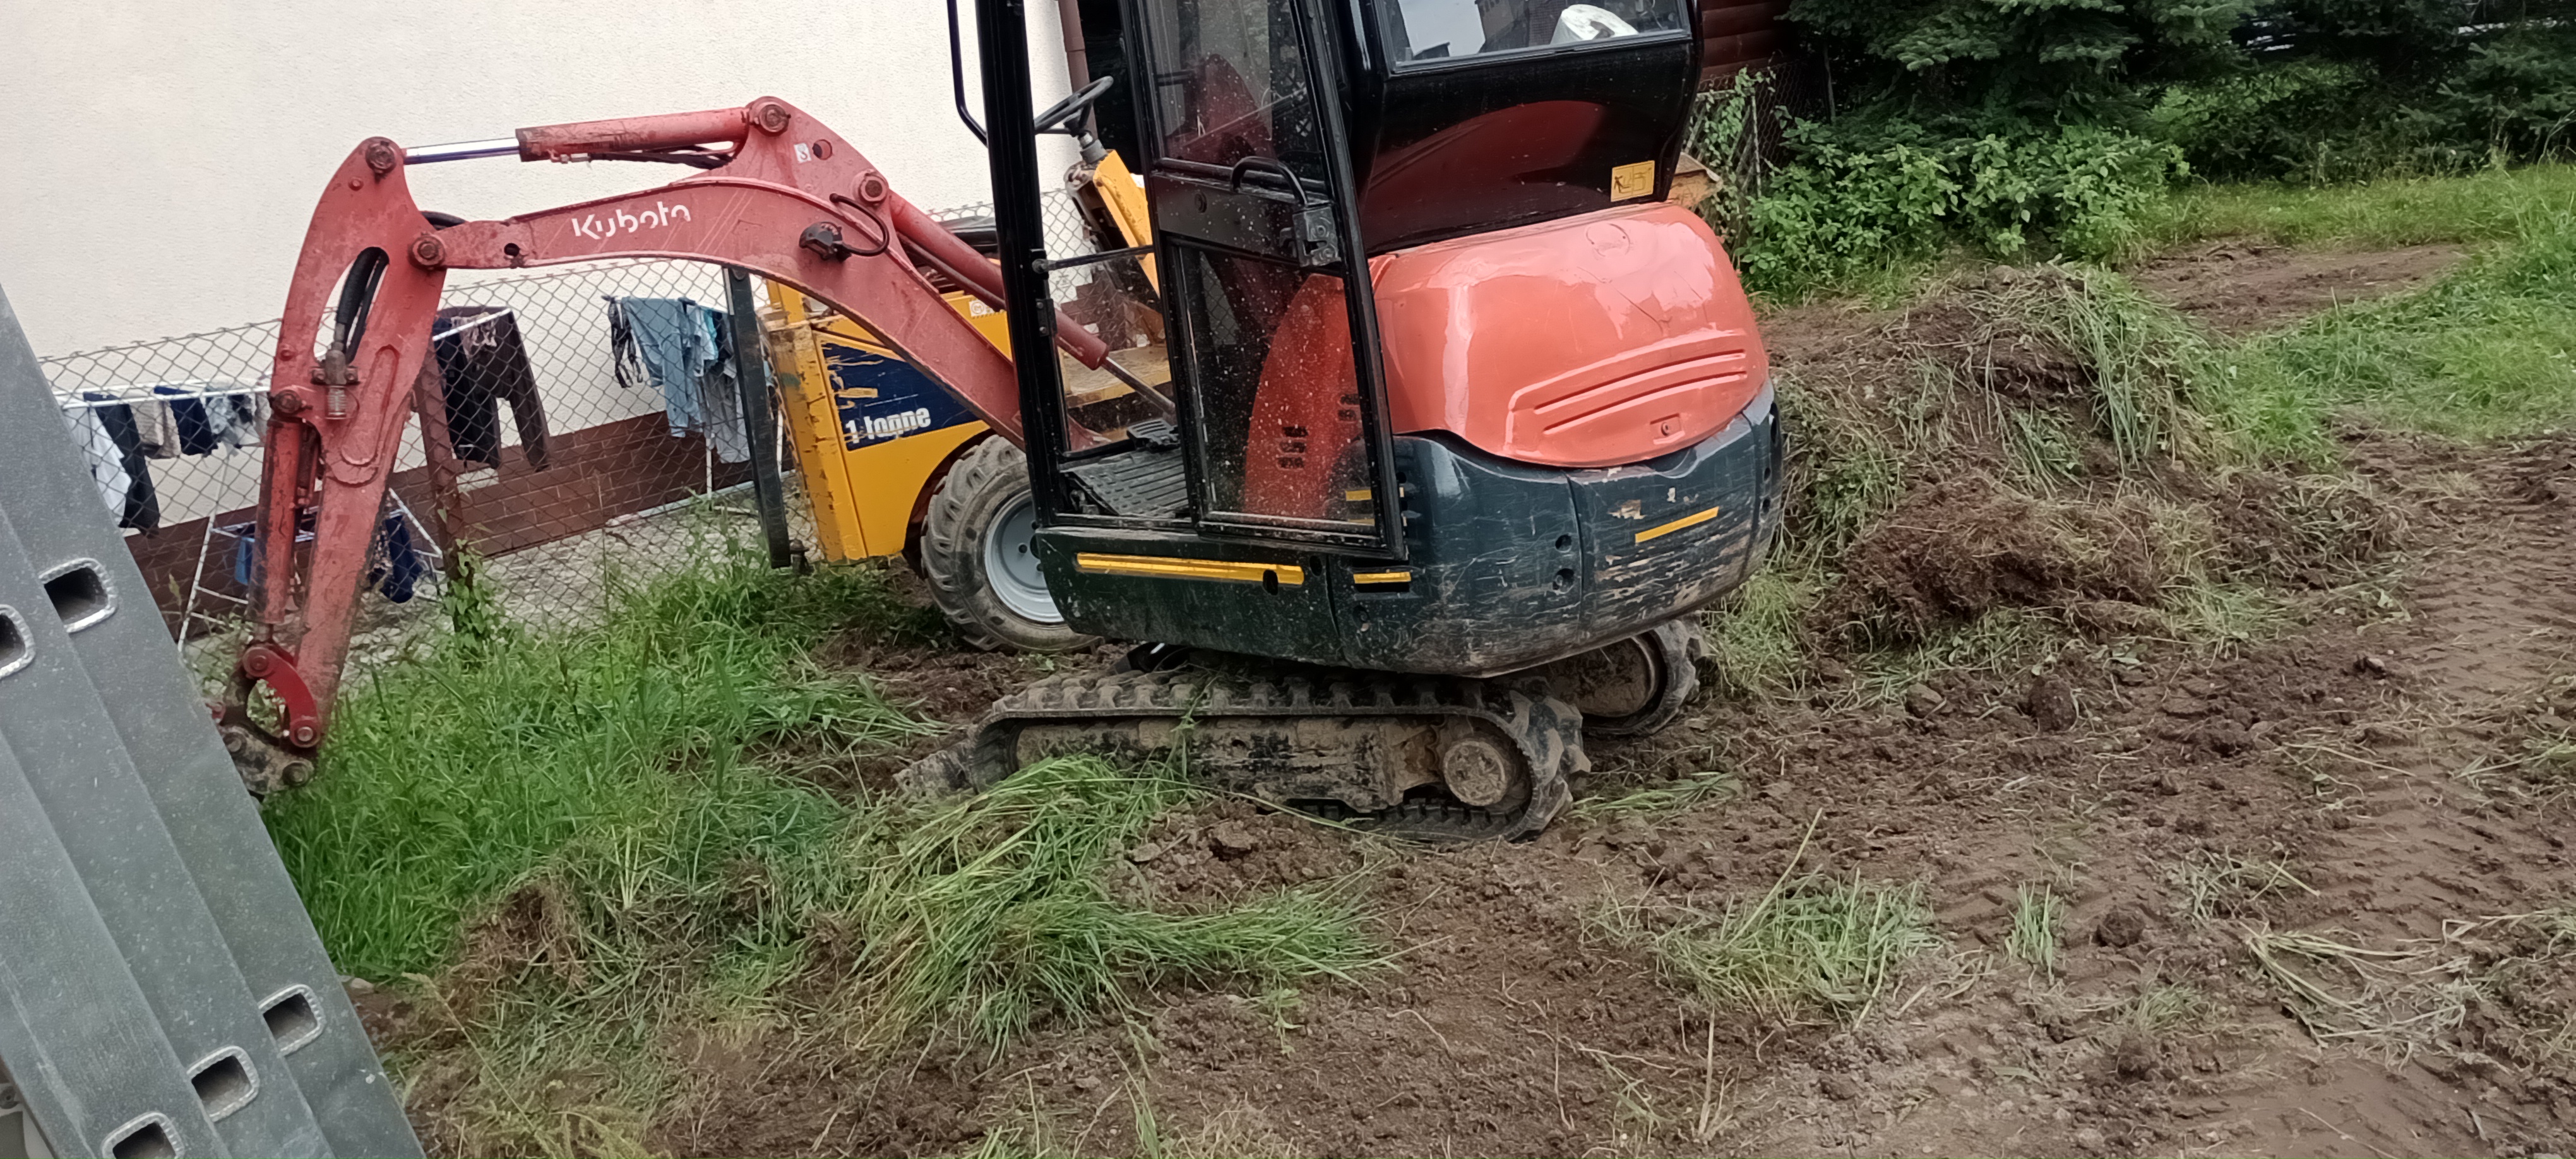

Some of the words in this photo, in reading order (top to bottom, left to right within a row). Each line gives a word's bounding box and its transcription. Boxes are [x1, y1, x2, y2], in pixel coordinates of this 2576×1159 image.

[571, 201, 691, 240] Kubota
[845, 419, 860, 444] 1
[863, 407, 931, 440] tonne
